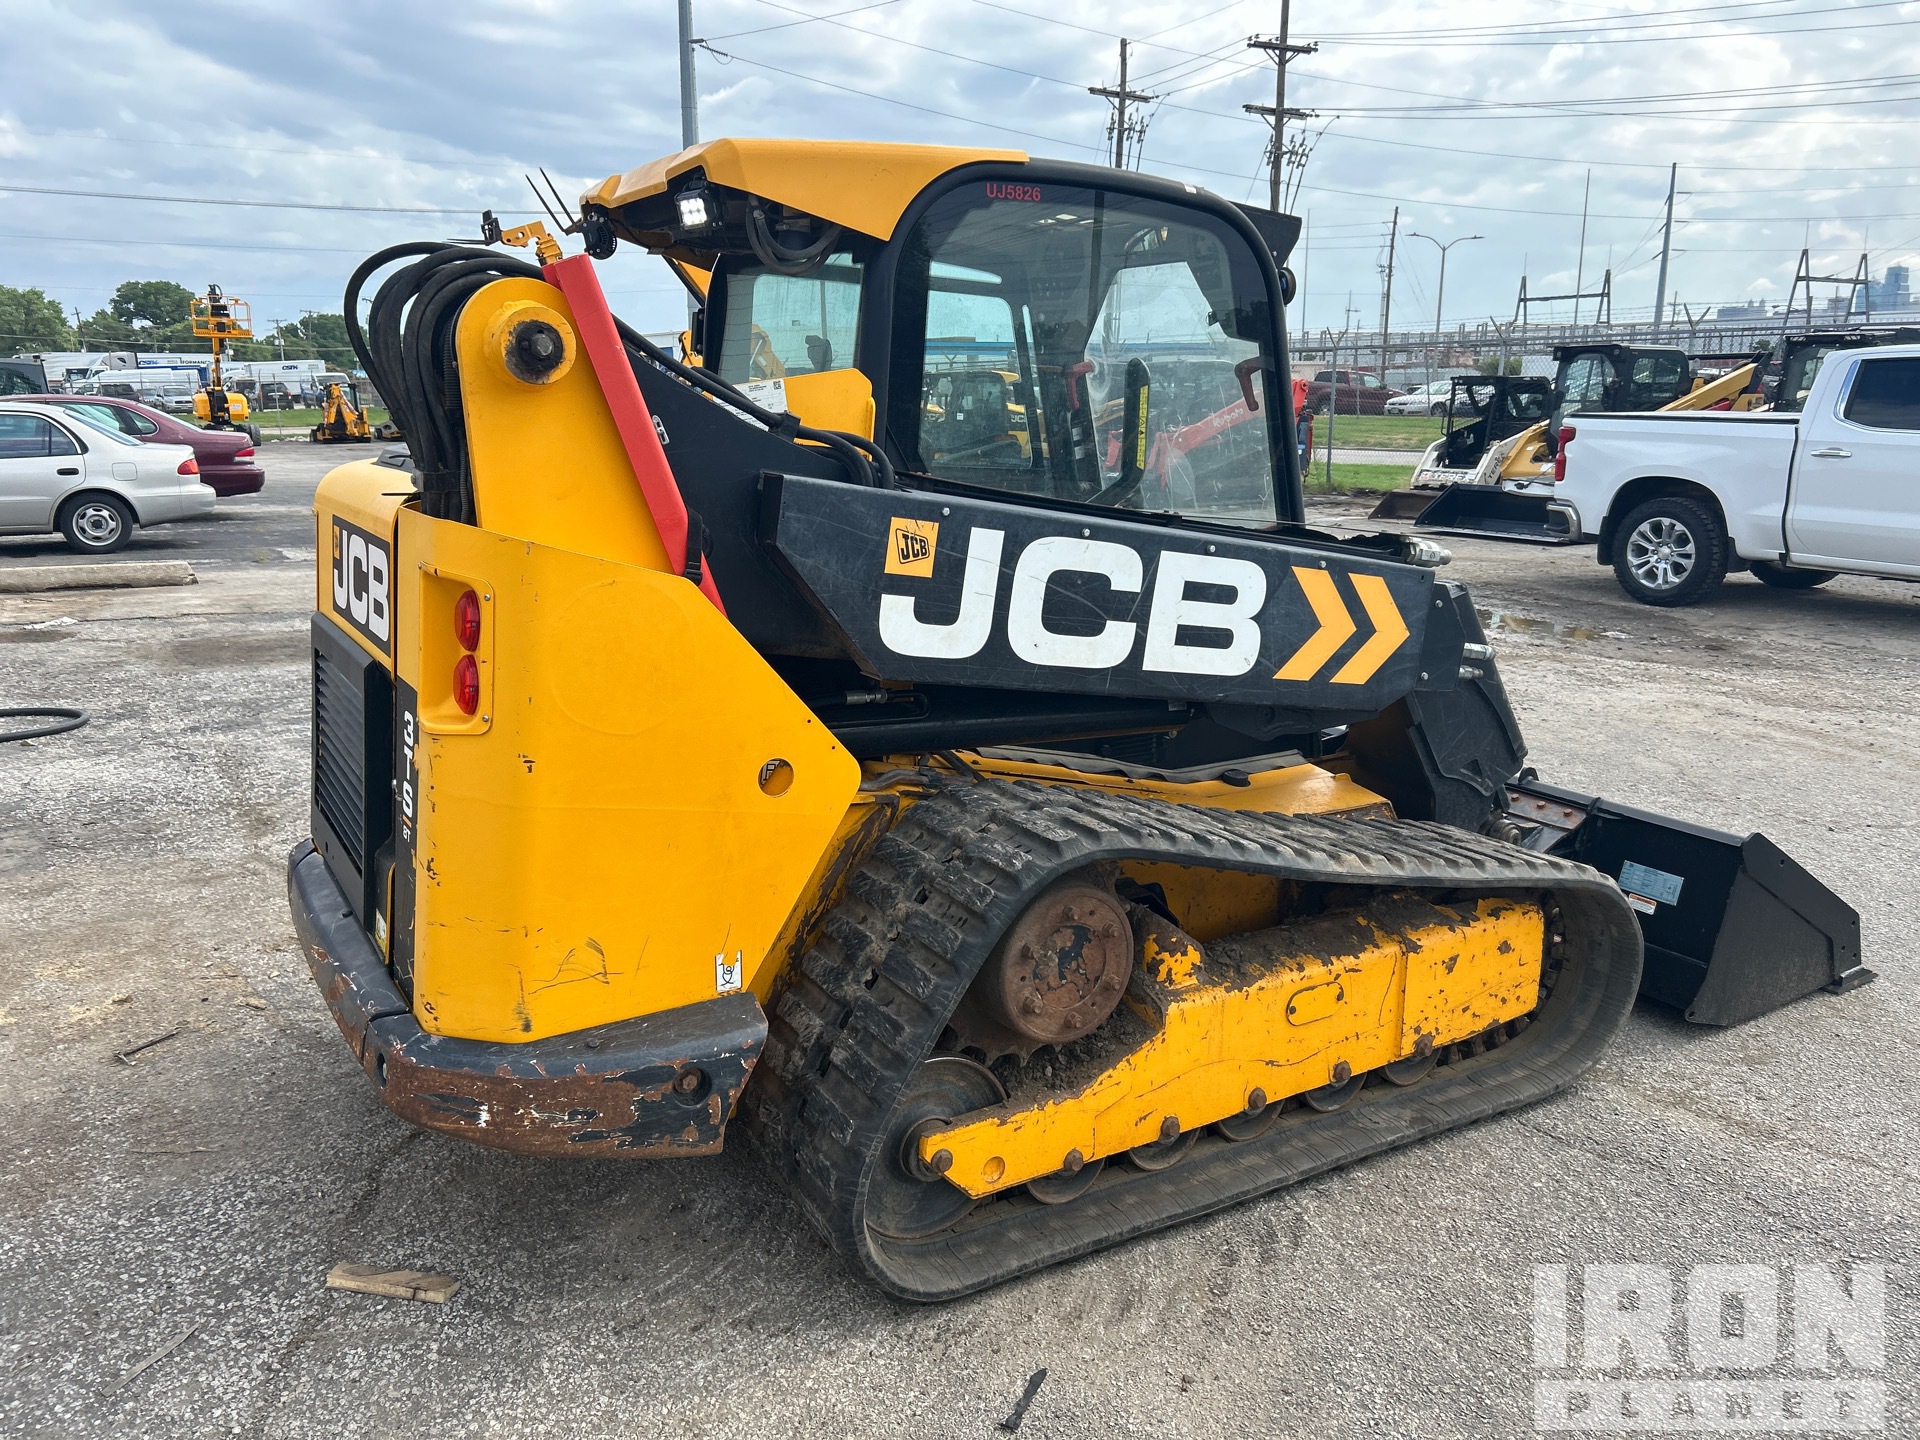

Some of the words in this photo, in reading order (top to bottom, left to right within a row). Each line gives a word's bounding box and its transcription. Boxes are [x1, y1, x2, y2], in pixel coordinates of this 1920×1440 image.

[986, 182, 1041, 202] UJ5826
[900, 533, 928, 561] JCB
[333, 529, 390, 642] JCB
[879, 527, 1267, 677] JCB
